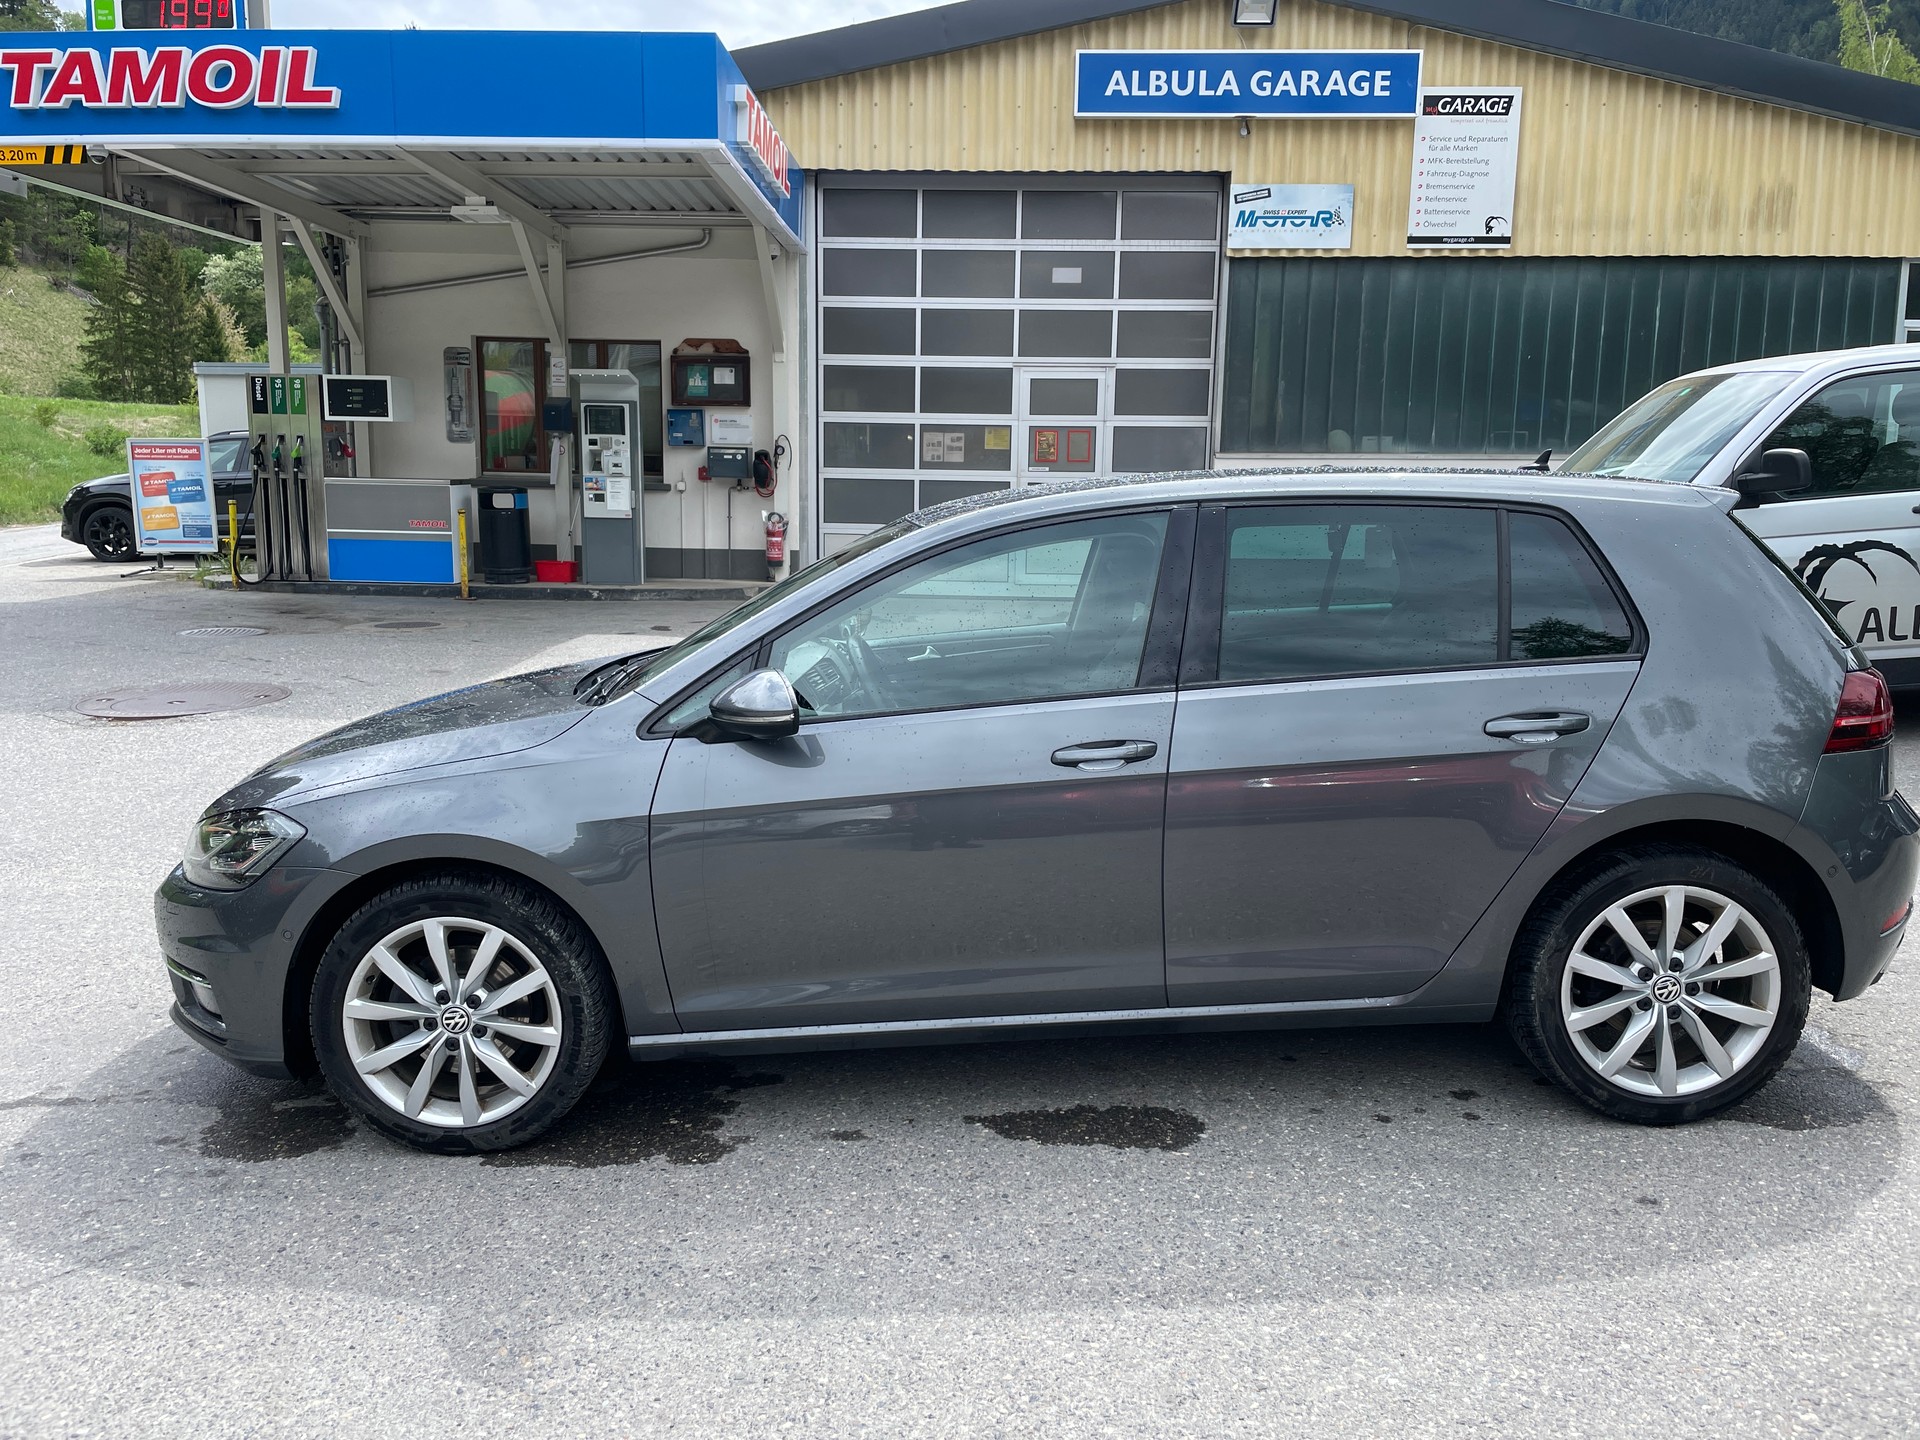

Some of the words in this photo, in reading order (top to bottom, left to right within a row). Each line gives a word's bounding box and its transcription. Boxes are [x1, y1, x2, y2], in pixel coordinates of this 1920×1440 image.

[0, 45, 342, 109] TAMOIL
[1104, 69, 1241, 97] ALBULA
[1249, 69, 1392, 97] GARAGE
[736, 84, 791, 200] TAMOIL
[1468, 136, 1509, 144] Reparaturen
[0, 149, 24, 161] 3.20
[25, 152, 38, 161] m
[1427, 157, 1490, 166] MFK-Bereitstellung
[1426, 170, 1490, 178] Fahrzeug-Diagnose
[1423, 208, 1471, 216] Batterieservice
[1442, 236, 1475, 244] mygarage.ch
[274, 378, 282, 389] 95
[293, 378, 301, 389] 98
[255, 377, 264, 401] Diesel
[151, 512, 176, 520] TAMOIL
[408, 519, 449, 528] TAMOIL
